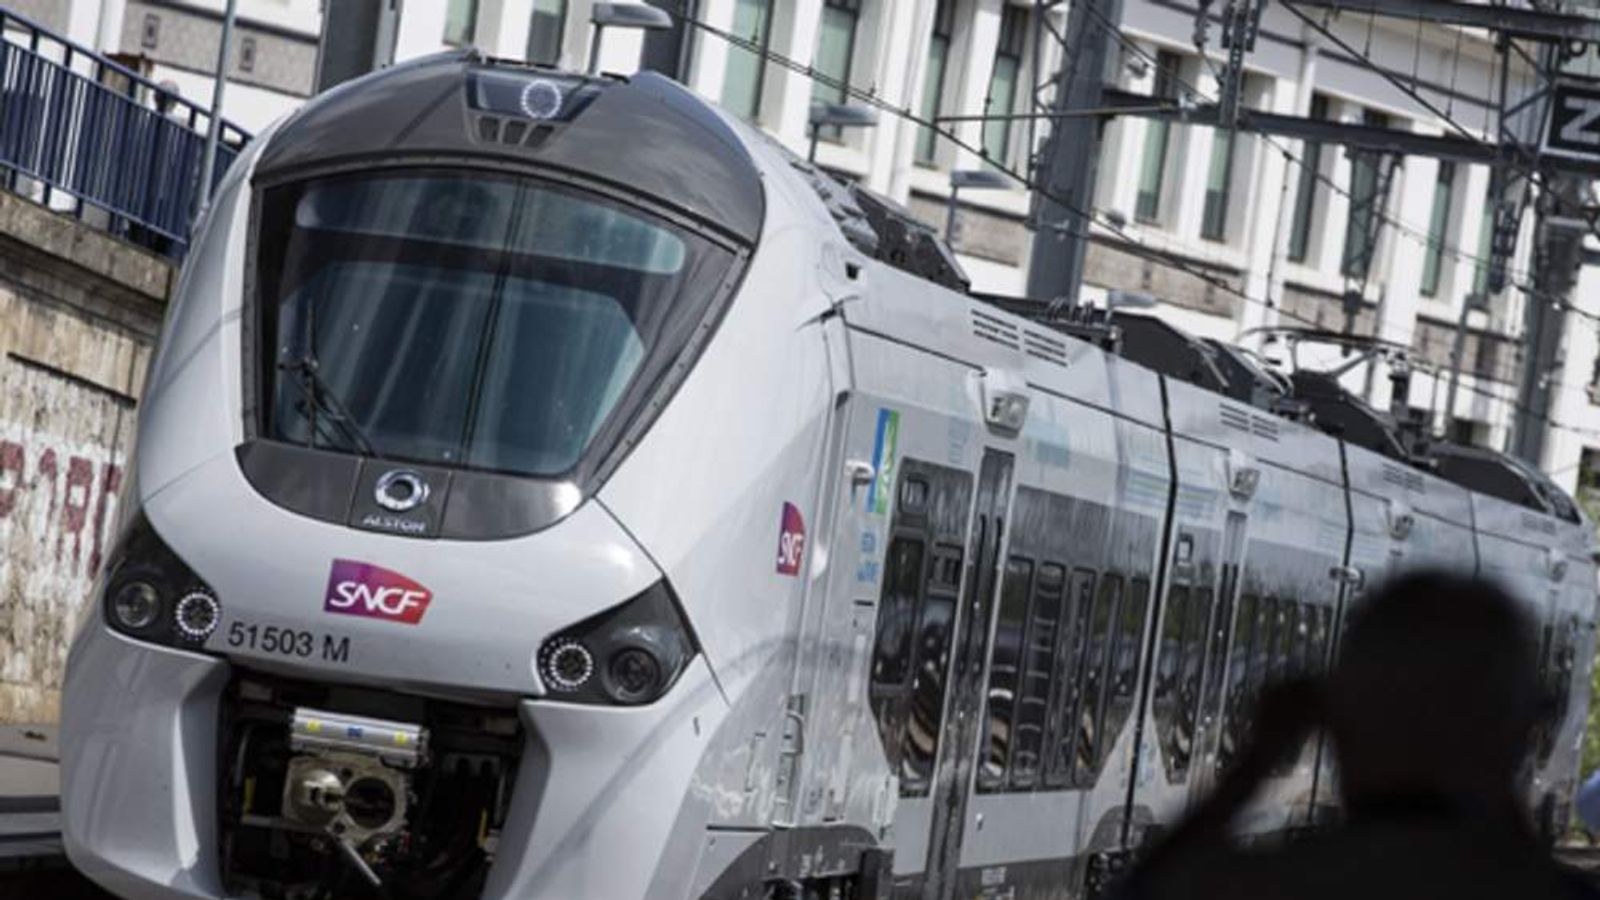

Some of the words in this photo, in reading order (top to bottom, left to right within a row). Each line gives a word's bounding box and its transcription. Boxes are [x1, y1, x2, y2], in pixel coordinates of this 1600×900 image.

[329, 581, 426, 615] SNCF
[228, 621, 313, 657] 51503
[322, 634, 351, 663] M
